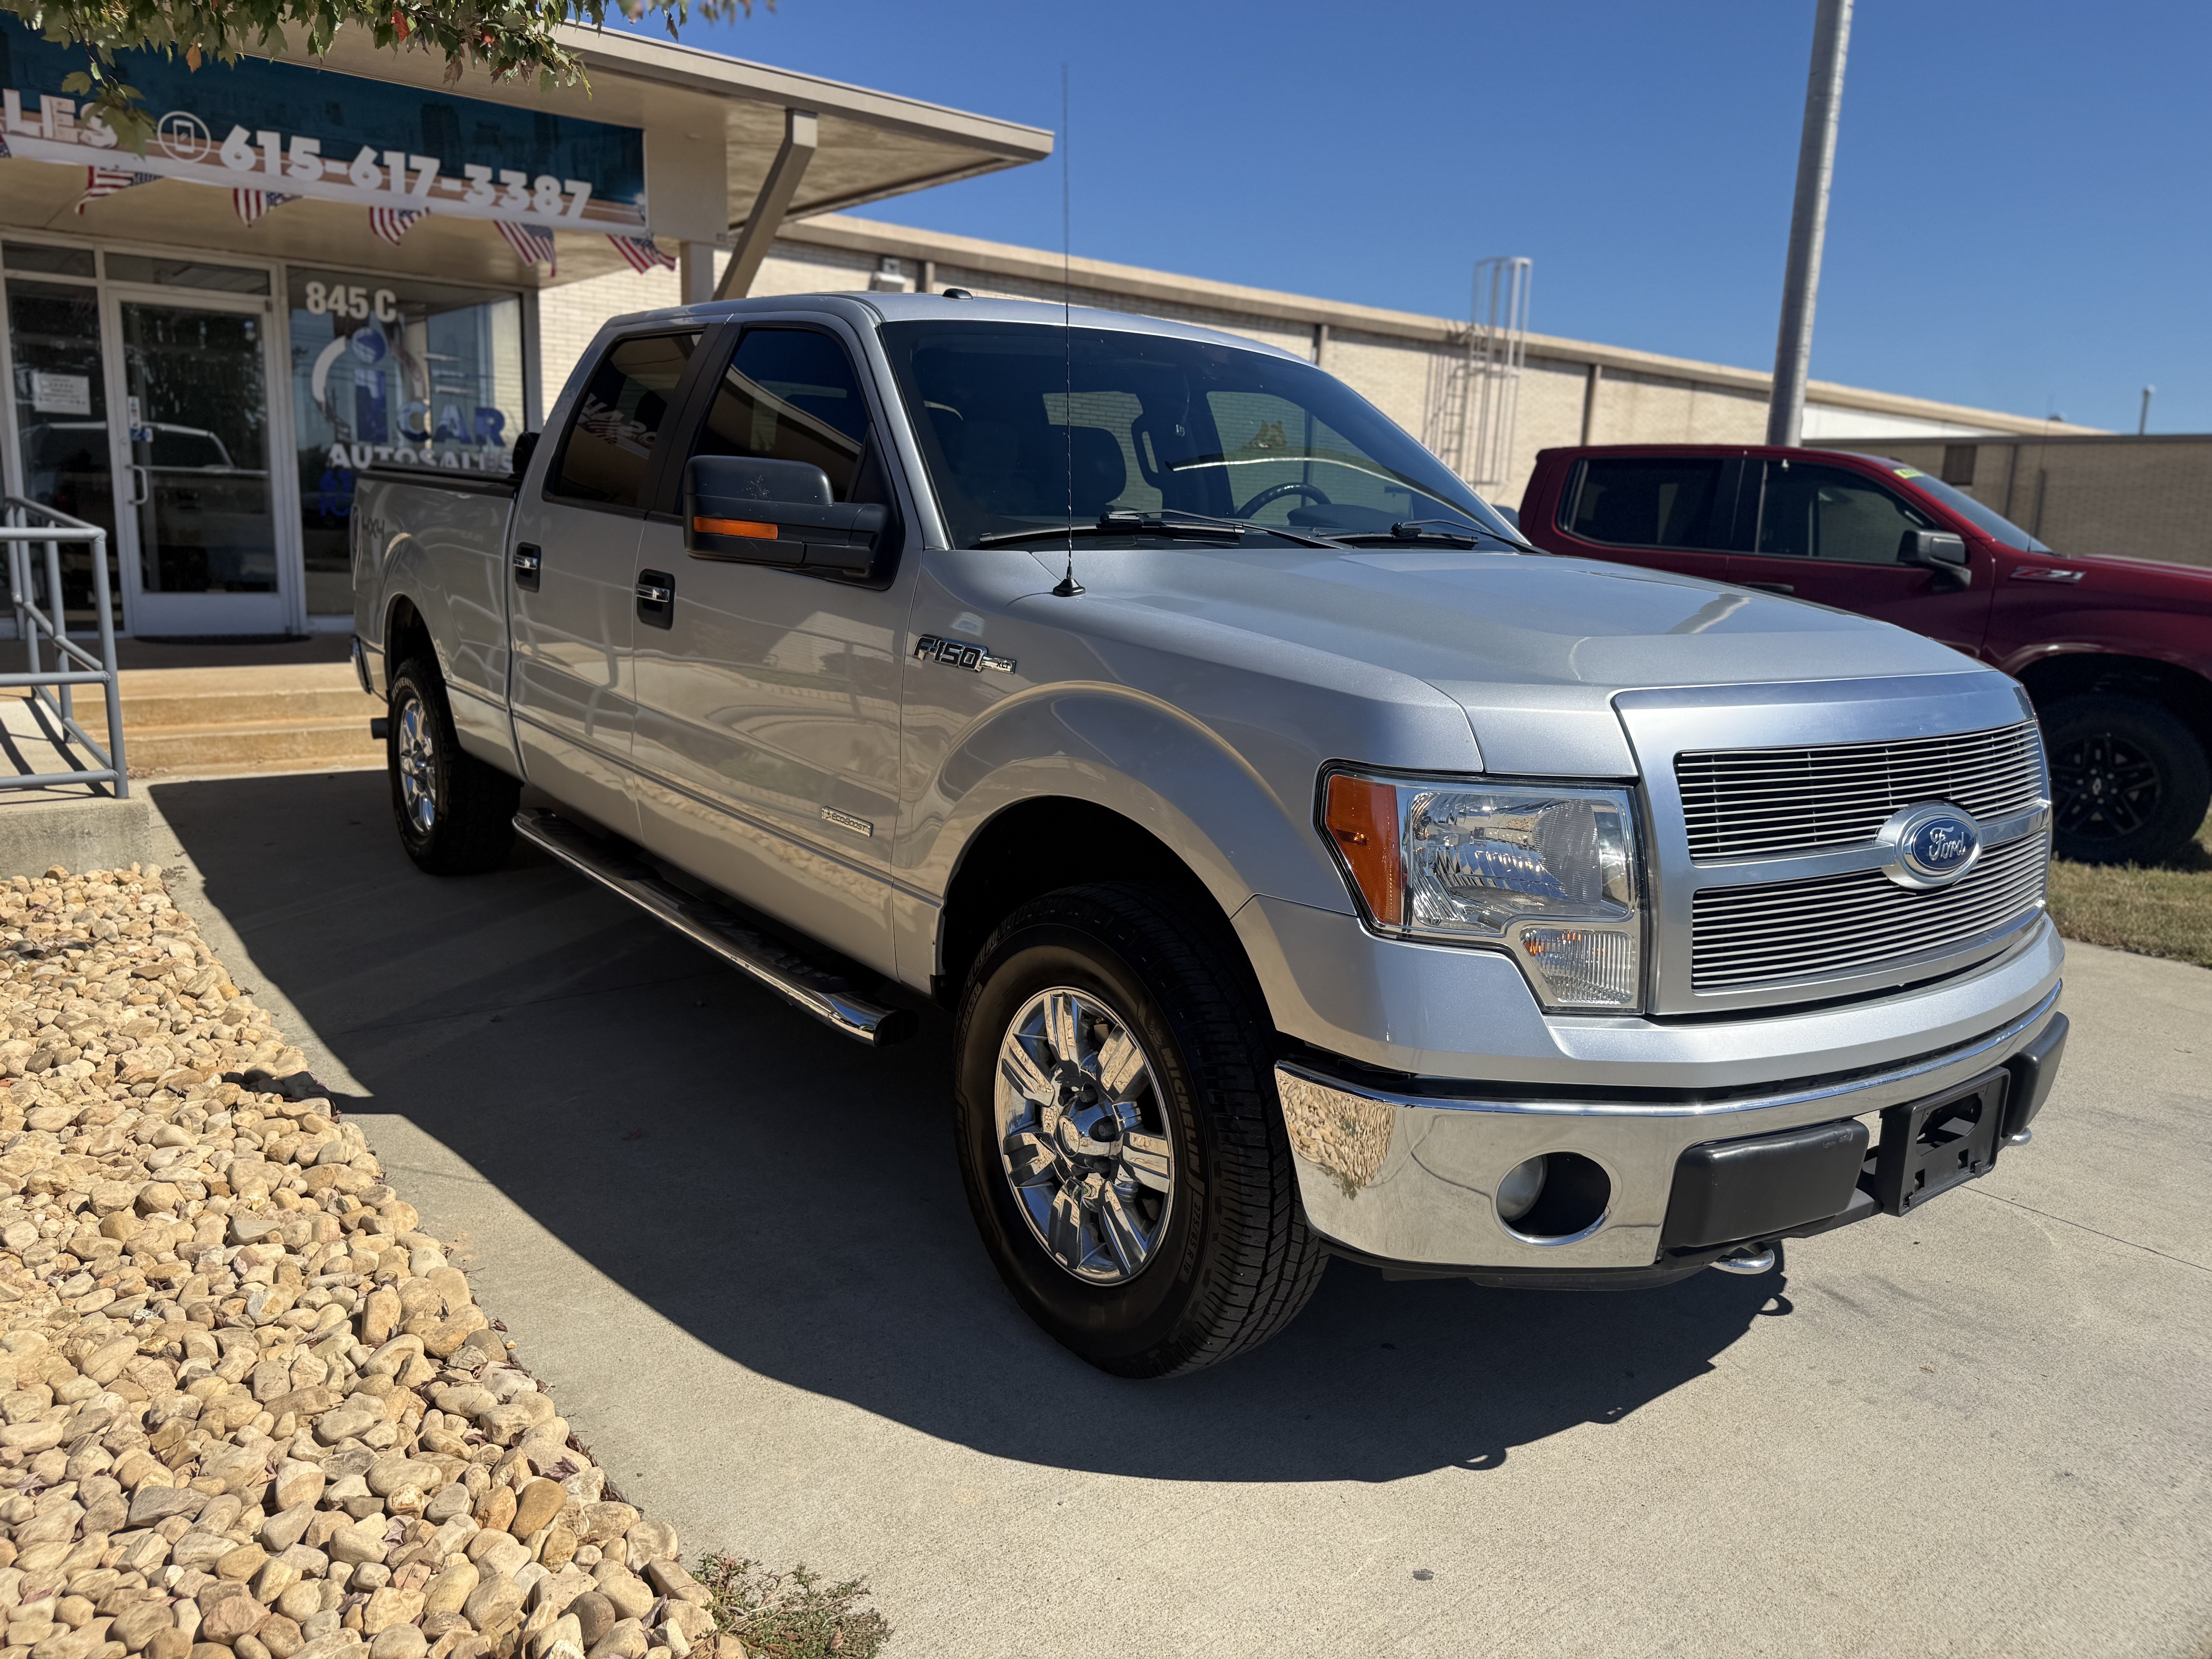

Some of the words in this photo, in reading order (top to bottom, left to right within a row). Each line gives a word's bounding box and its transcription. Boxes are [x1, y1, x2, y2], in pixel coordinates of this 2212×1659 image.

[0, 88, 118, 148] LES
[220, 124, 592, 220] 615-617-3387
[306, 281, 369, 319] 845
[374, 289, 397, 323] C
[996, 660, 1010, 670] XLT
[1929, 826, 1966, 861] Ford
[1161, 1047, 1200, 1174] MICHELIN
[1190, 1202, 1200, 1249] 275/65
[1183, 1261, 1191, 1274] 18
